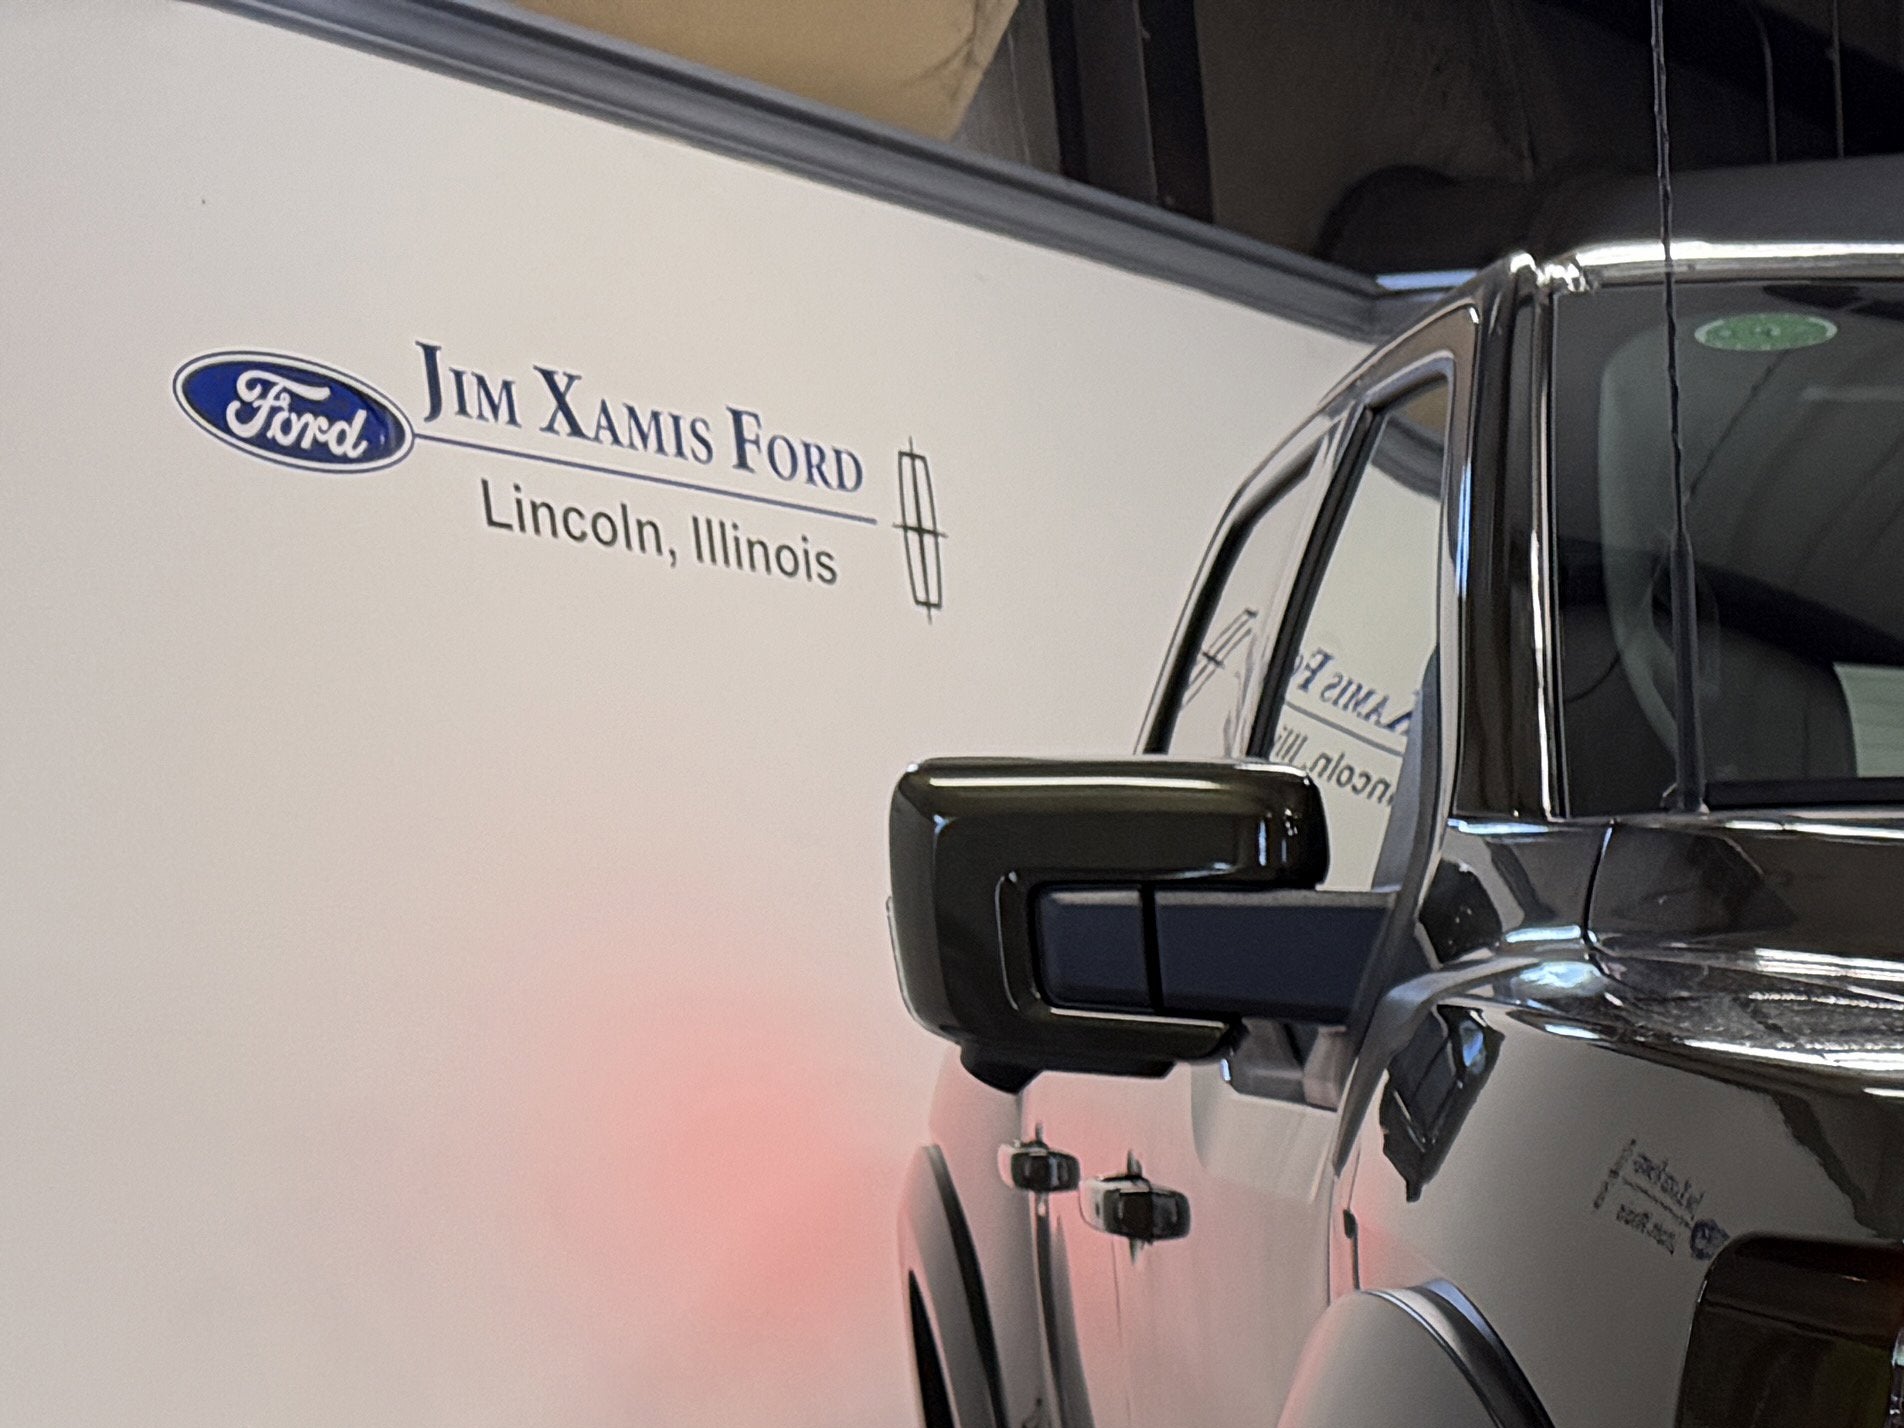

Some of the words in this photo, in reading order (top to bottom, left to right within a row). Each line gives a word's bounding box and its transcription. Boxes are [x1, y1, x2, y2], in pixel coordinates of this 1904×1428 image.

[227, 369, 369, 457] Ford
[415, 341, 522, 430] JIM
[533, 364, 714, 468] XAMIS
[725, 405, 863, 493] FORD
[480, 478, 677, 569] Lincoln,
[692, 515, 838, 585] Illinois
